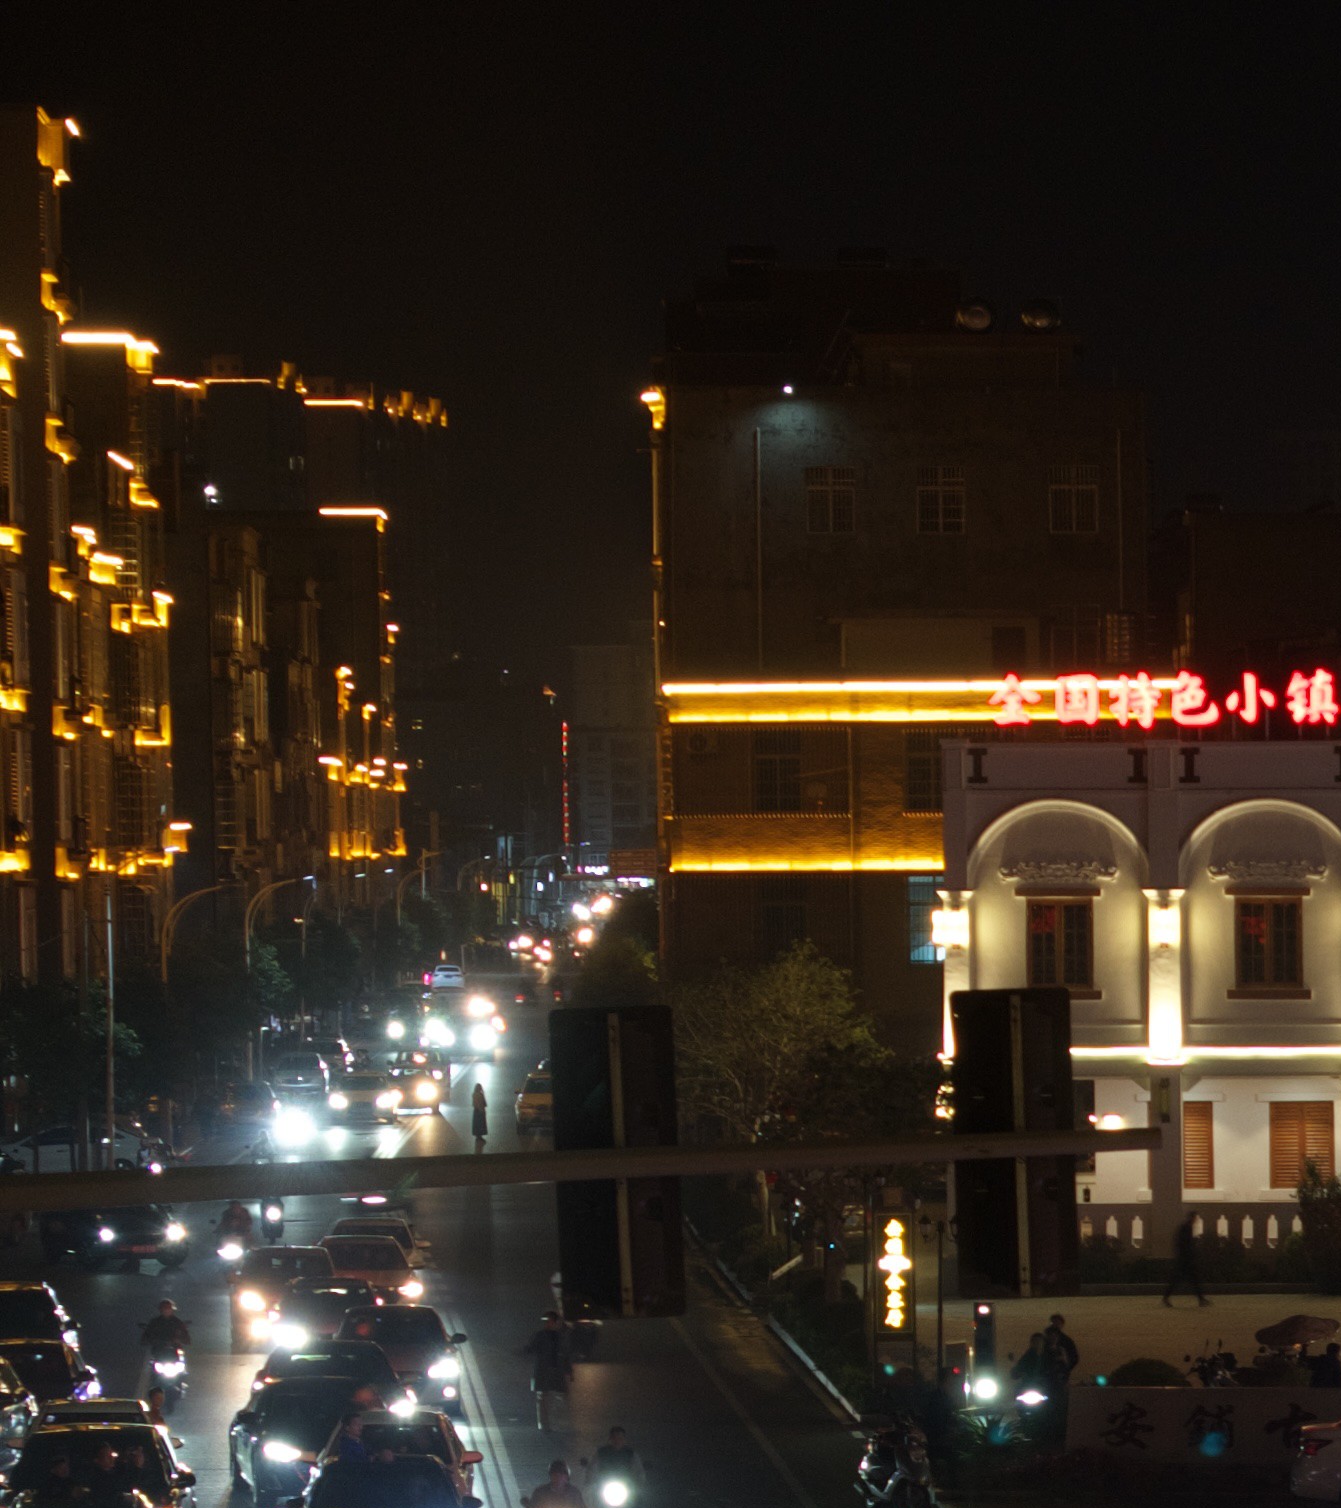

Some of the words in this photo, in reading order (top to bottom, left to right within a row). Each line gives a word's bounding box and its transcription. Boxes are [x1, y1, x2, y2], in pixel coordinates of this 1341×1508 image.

[988, 668, 1340, 729] 全国特色小镇
